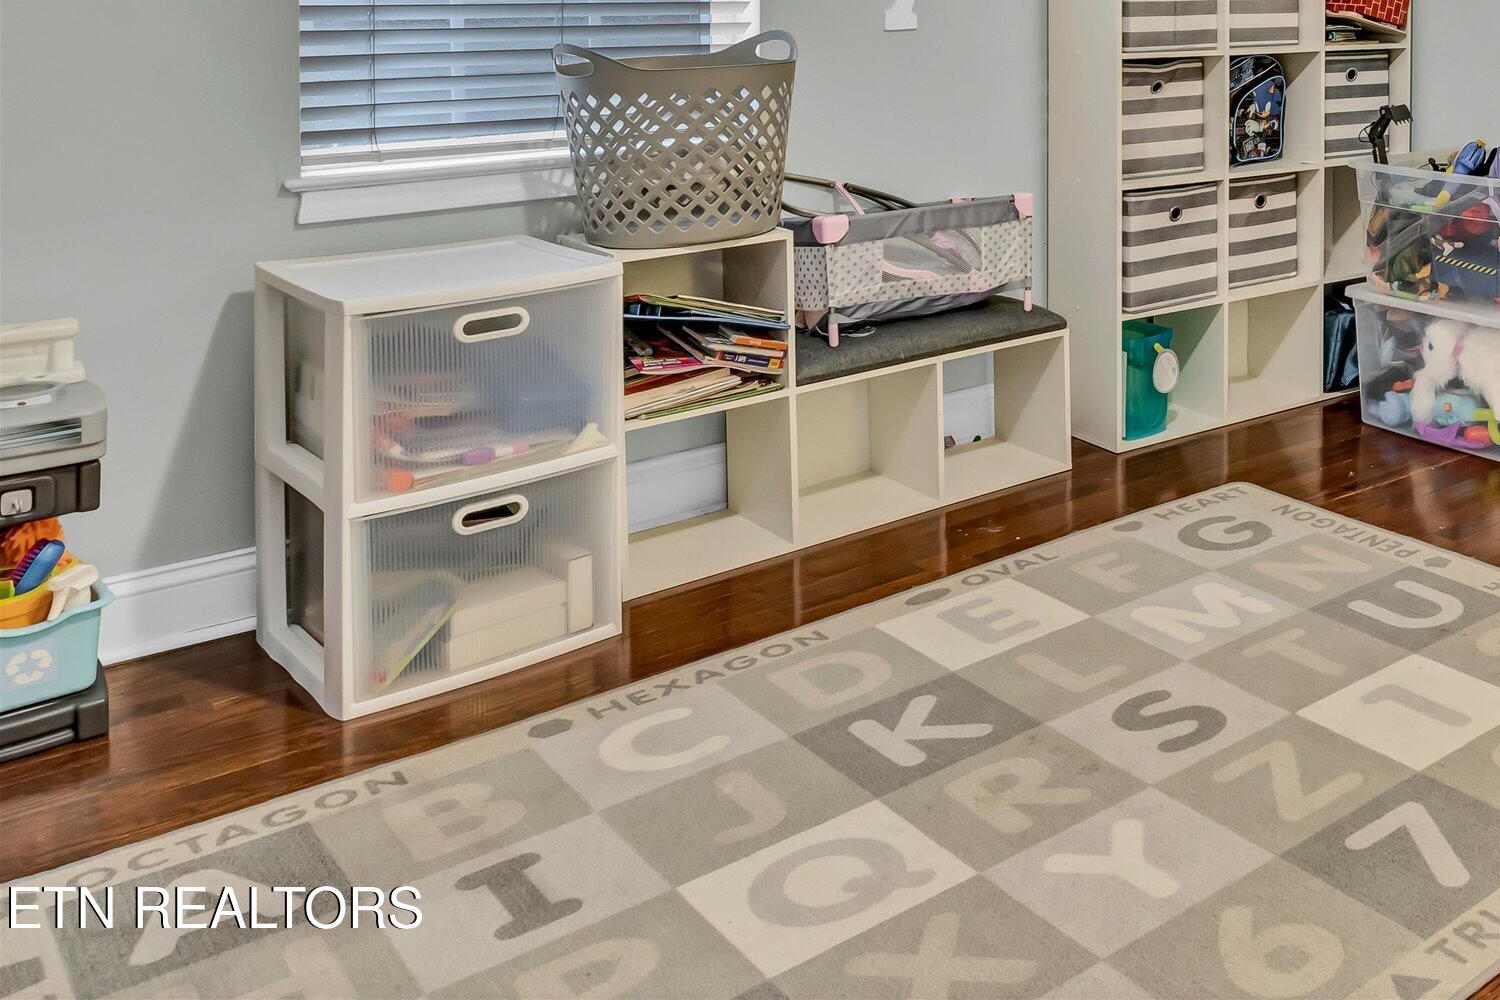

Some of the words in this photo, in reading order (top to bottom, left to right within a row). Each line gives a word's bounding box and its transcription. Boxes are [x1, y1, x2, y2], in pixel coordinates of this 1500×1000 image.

[1153, 485, 1251, 521] HEART
[1177, 515, 1274, 551] G
[1271, 501, 1421, 566] PENTAGON
[961, 551, 1058, 587] OVAL
[1073, 551, 1140, 593] F
[1250, 547, 1373, 592] N
[938, 596, 1041, 644] E
[1129, 581, 1275, 644] M
[1347, 578, 1464, 629] U
[587, 629, 830, 720] HEXAGON
[766, 651, 892, 712] D
[1016, 652, 1128, 693] L
[1218, 627, 1347, 677] T
[848, 694, 993, 768] K
[1111, 689, 1227, 753] S
[1360, 682, 1472, 727] 1
[600, 706, 731, 772] C
[712, 770, 788, 845] J
[944, 757, 1093, 834] R
[1215, 740, 1364, 823] Z
[66, 771, 408, 890] OCTAGON
[381, 781, 527, 862] B
[1344, 801, 1470, 888] 7
[748, 837, 936, 928] Q
[1043, 818, 1181, 899] Y
[129, 869, 304, 966] A
[455, 852, 583, 941] I
[1217, 905, 1345, 999] 6
